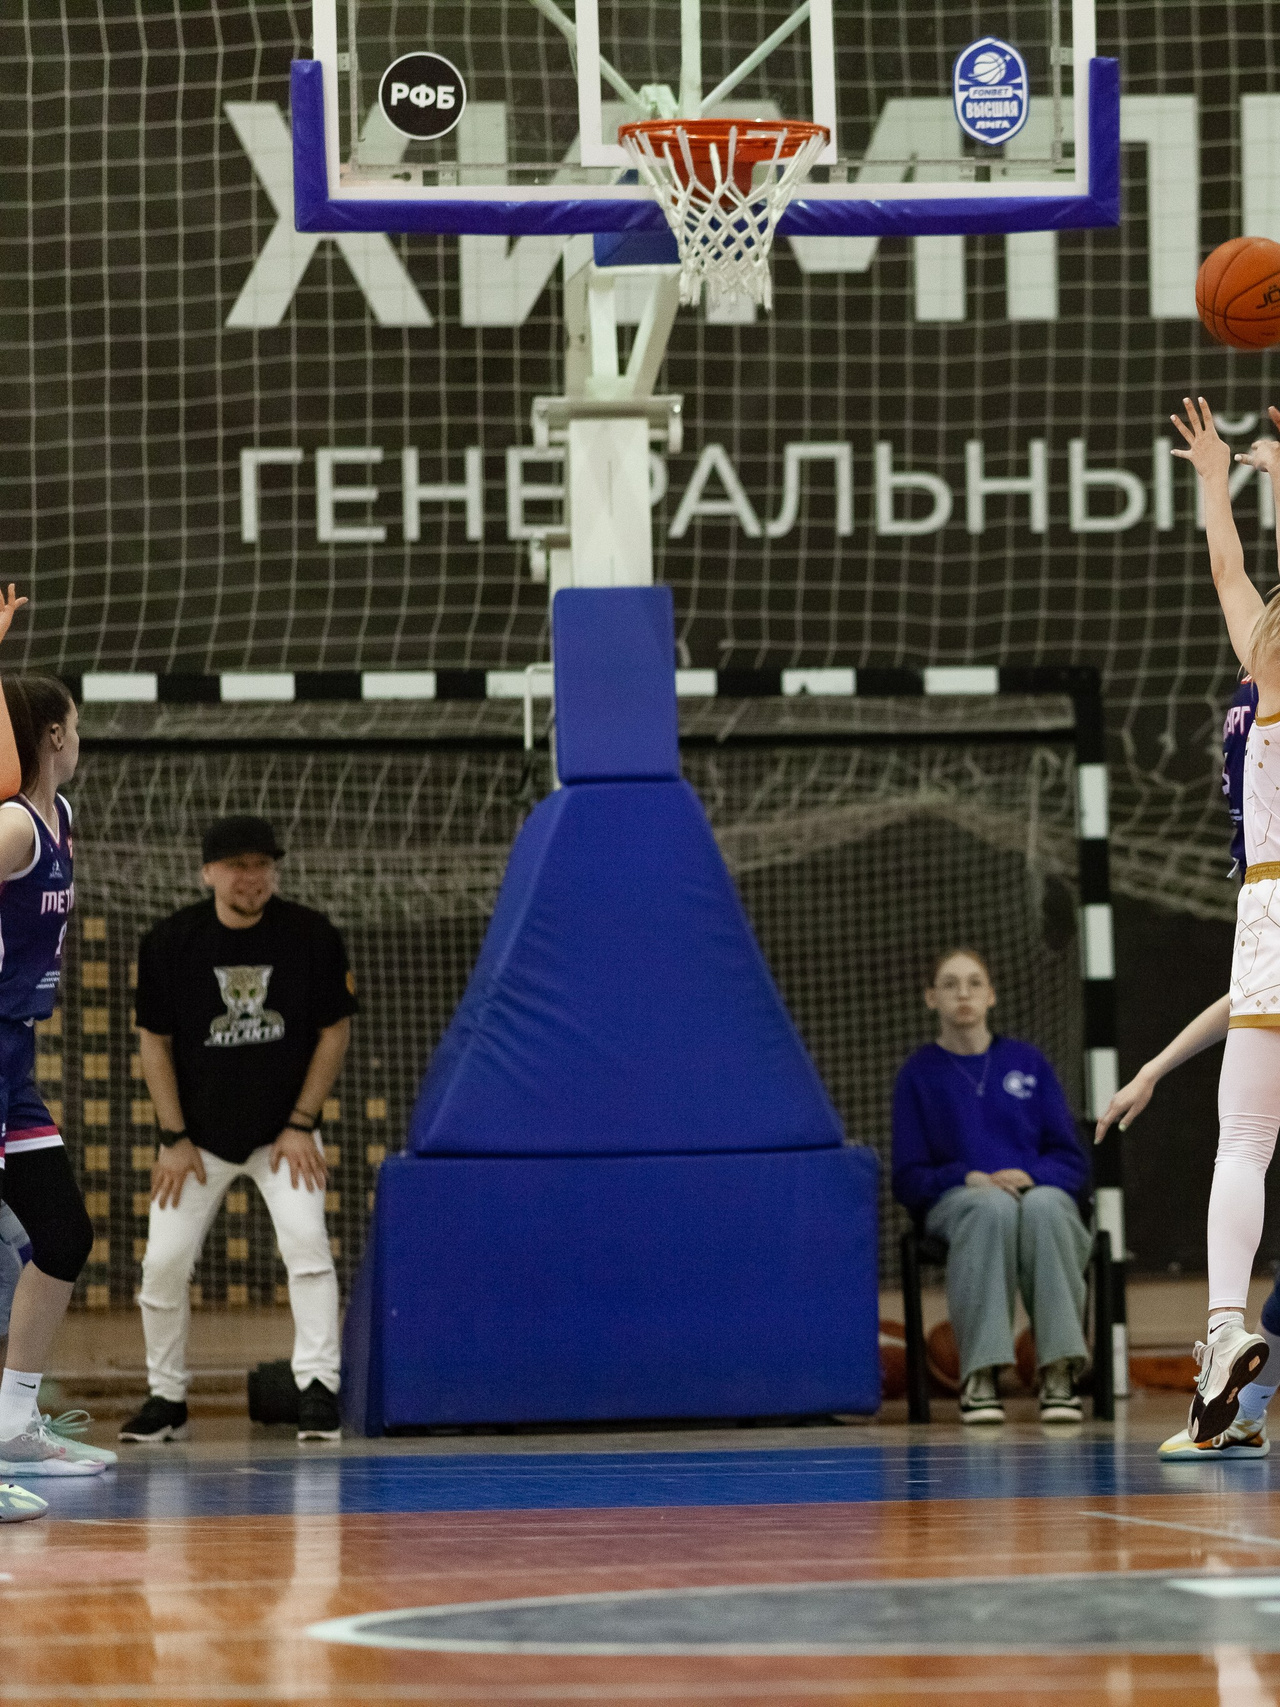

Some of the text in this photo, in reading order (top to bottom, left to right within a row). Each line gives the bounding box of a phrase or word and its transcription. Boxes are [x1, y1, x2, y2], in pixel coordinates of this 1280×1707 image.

[390, 82, 456, 110] РФБ
[972, 88, 1009, 97] FONBET
[965, 100, 1019, 119] ВЫСШАЯ
[975, 120, 1011, 130] ЛИГА
